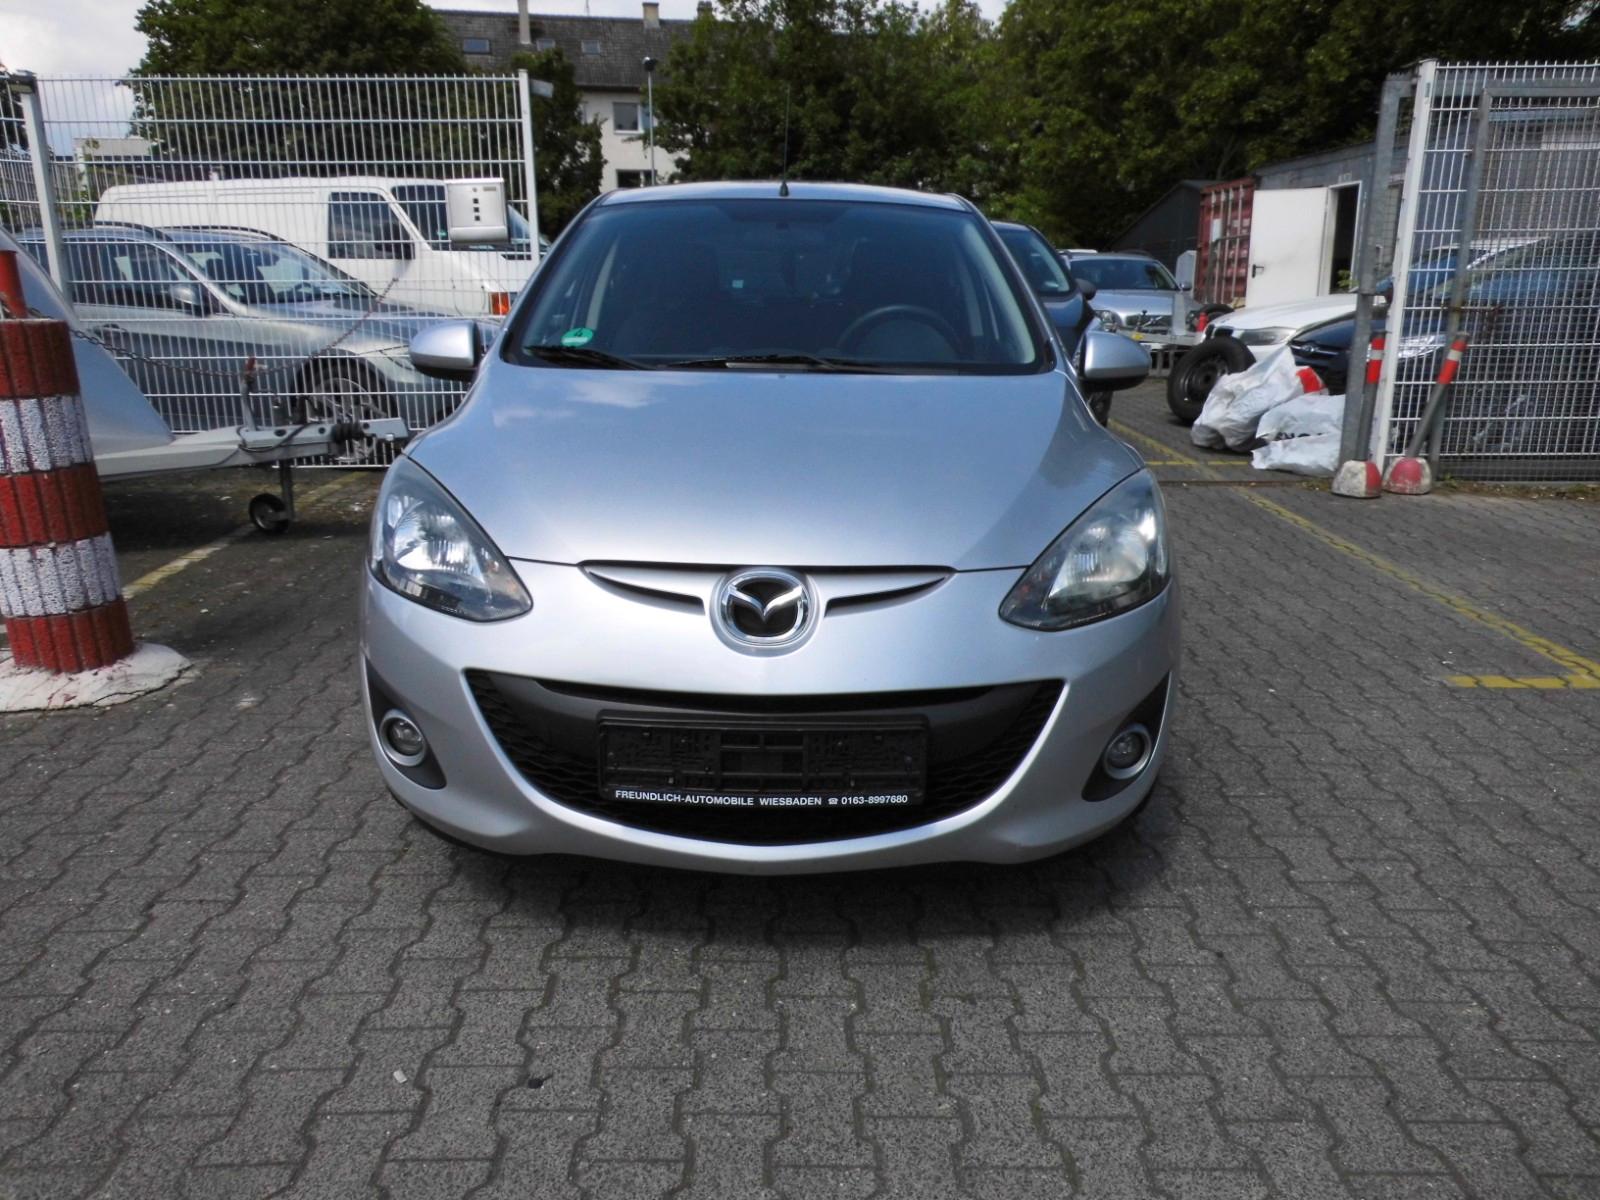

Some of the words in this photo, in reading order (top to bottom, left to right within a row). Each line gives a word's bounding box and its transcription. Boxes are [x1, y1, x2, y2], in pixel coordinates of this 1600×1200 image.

[615, 790, 754, 806] FREUNDLICH-AUTOMOBILE
[759, 797, 822, 805] WIESBADEN
[841, 794, 908, 805] 0163-8997680
